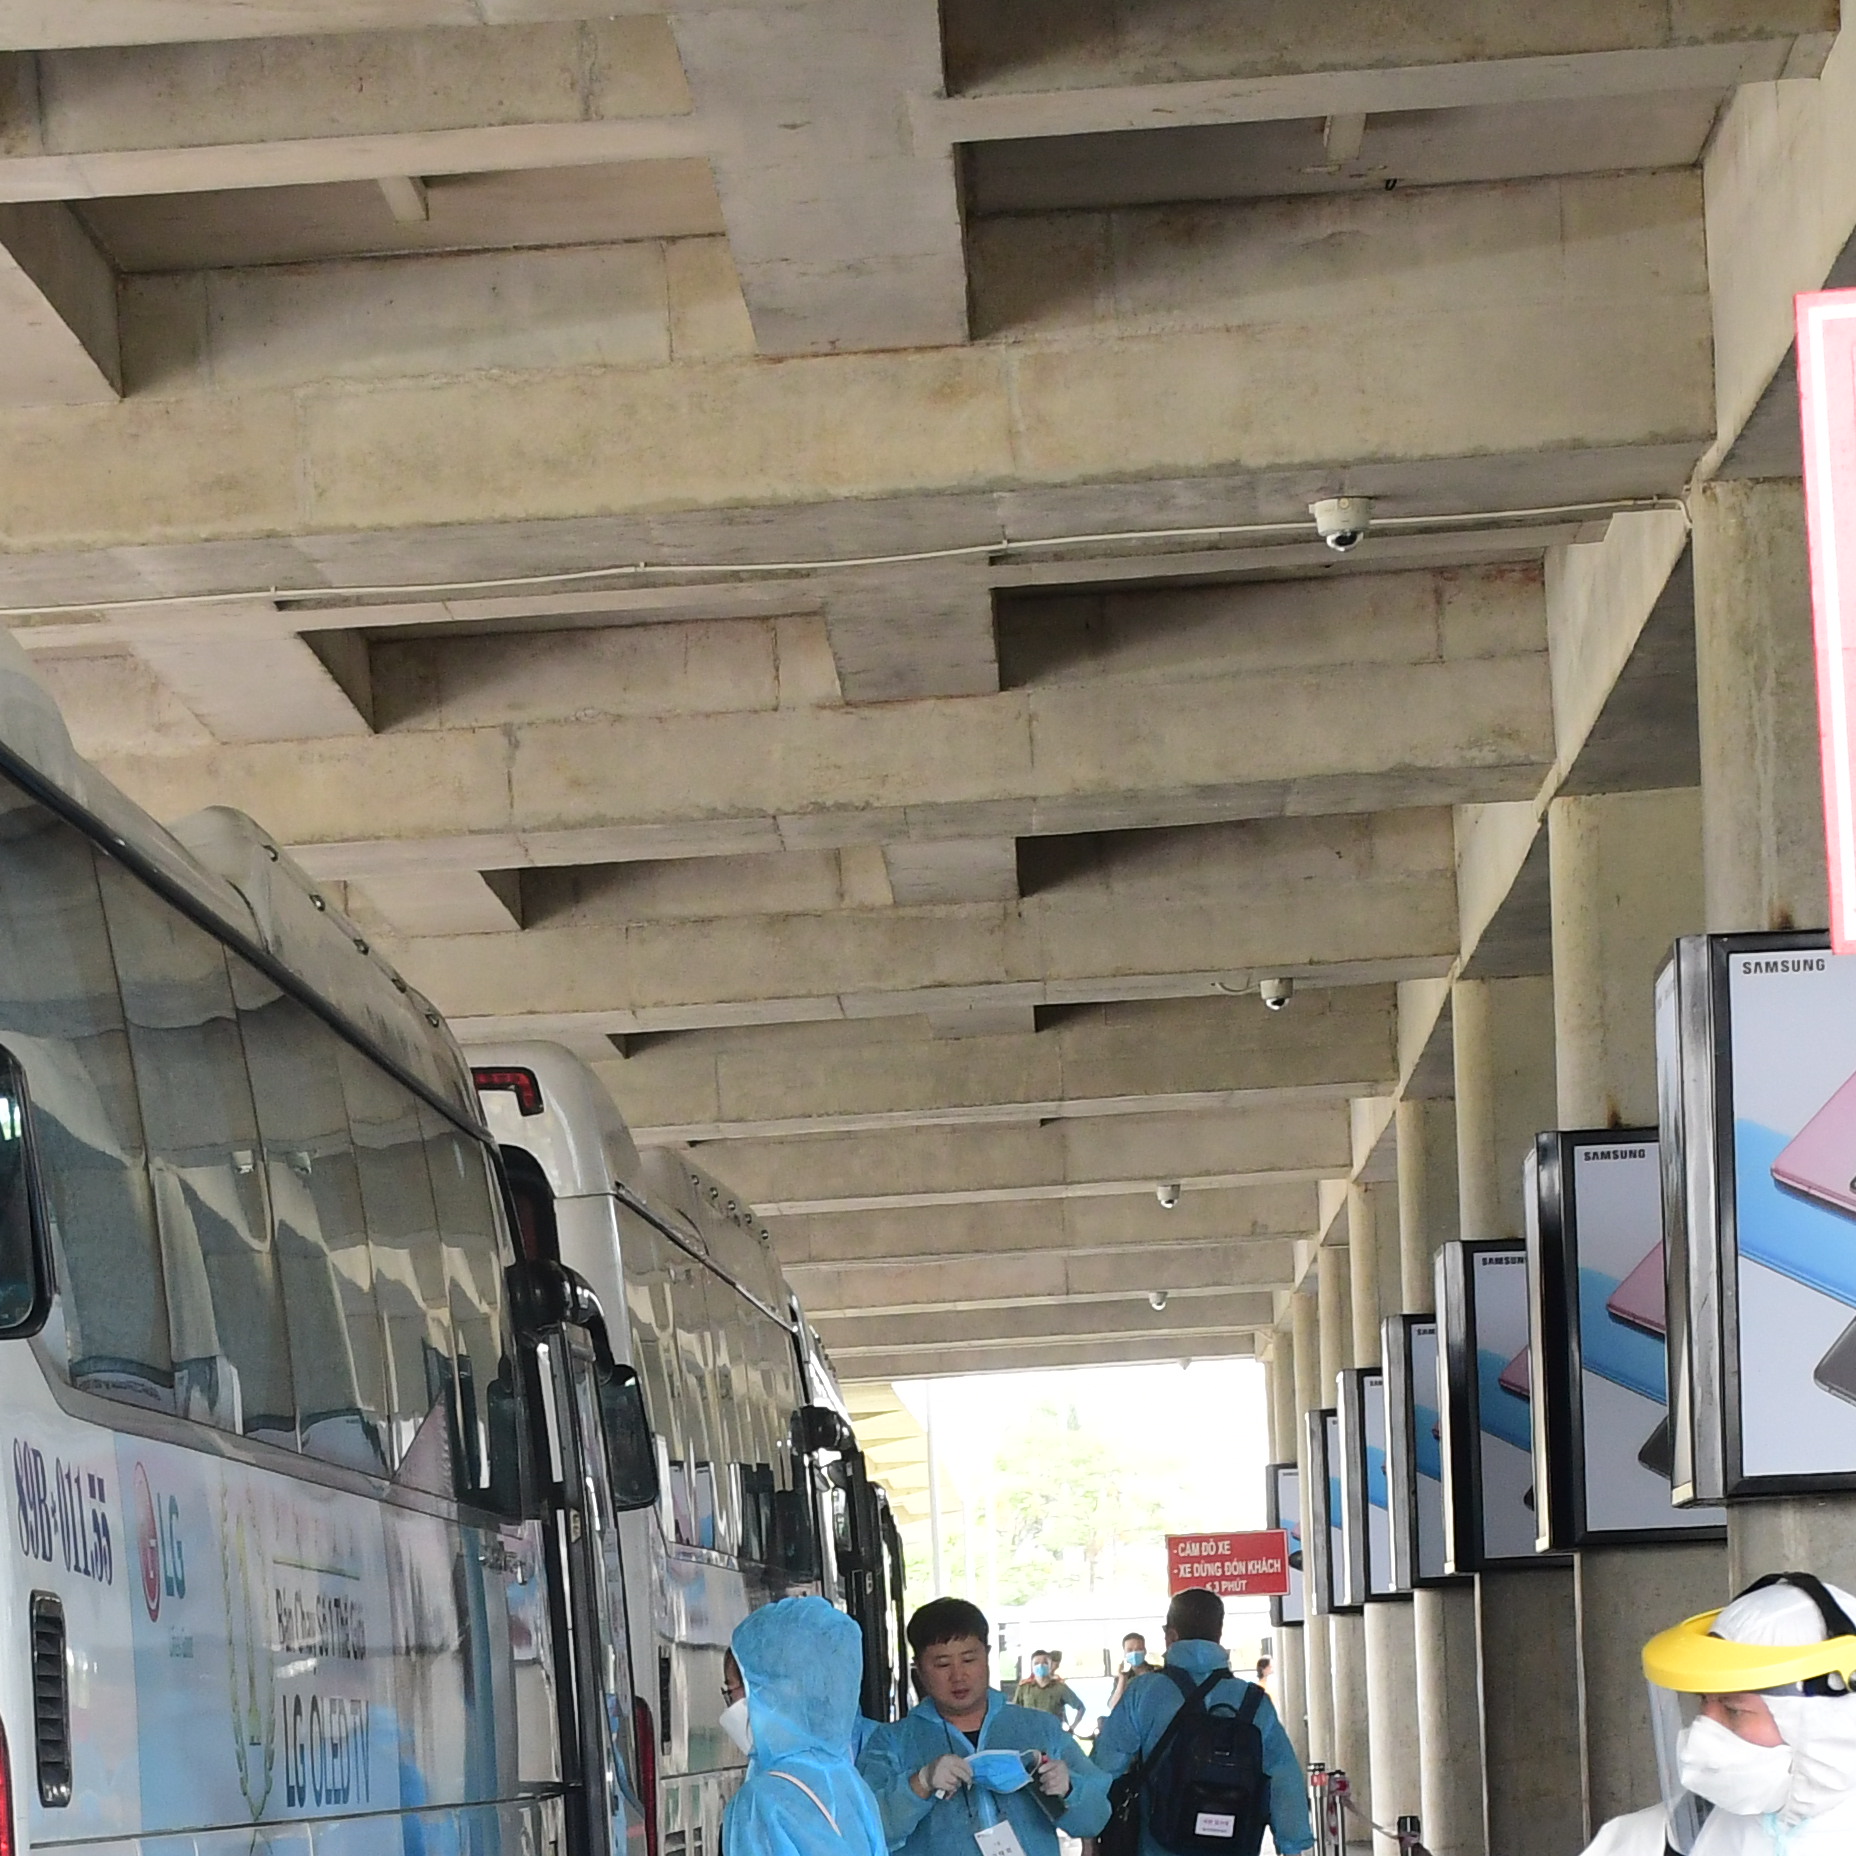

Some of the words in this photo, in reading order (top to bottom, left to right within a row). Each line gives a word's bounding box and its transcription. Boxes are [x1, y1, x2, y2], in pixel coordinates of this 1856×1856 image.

[1741, 957, 1826, 975] SAMSUNG
[1583, 1148, 1646, 1162] SAMSUNG
[1482, 1256, 1525, 1266] SAMSUN
[157, 1492, 186, 1599] LG
[1217, 1541, 1231, 1555] XE
[1178, 1563, 1192, 1578] XE
[1224, 1558, 1246, 1576] ĐÓN
[1247, 1557, 1281, 1574] KHÁCH
[1221, 1577, 1247, 1592] PHÚT
[282, 1694, 306, 1808] LG
[310, 1694, 350, 1808] OLED
[350, 1699, 370, 1804] TV
